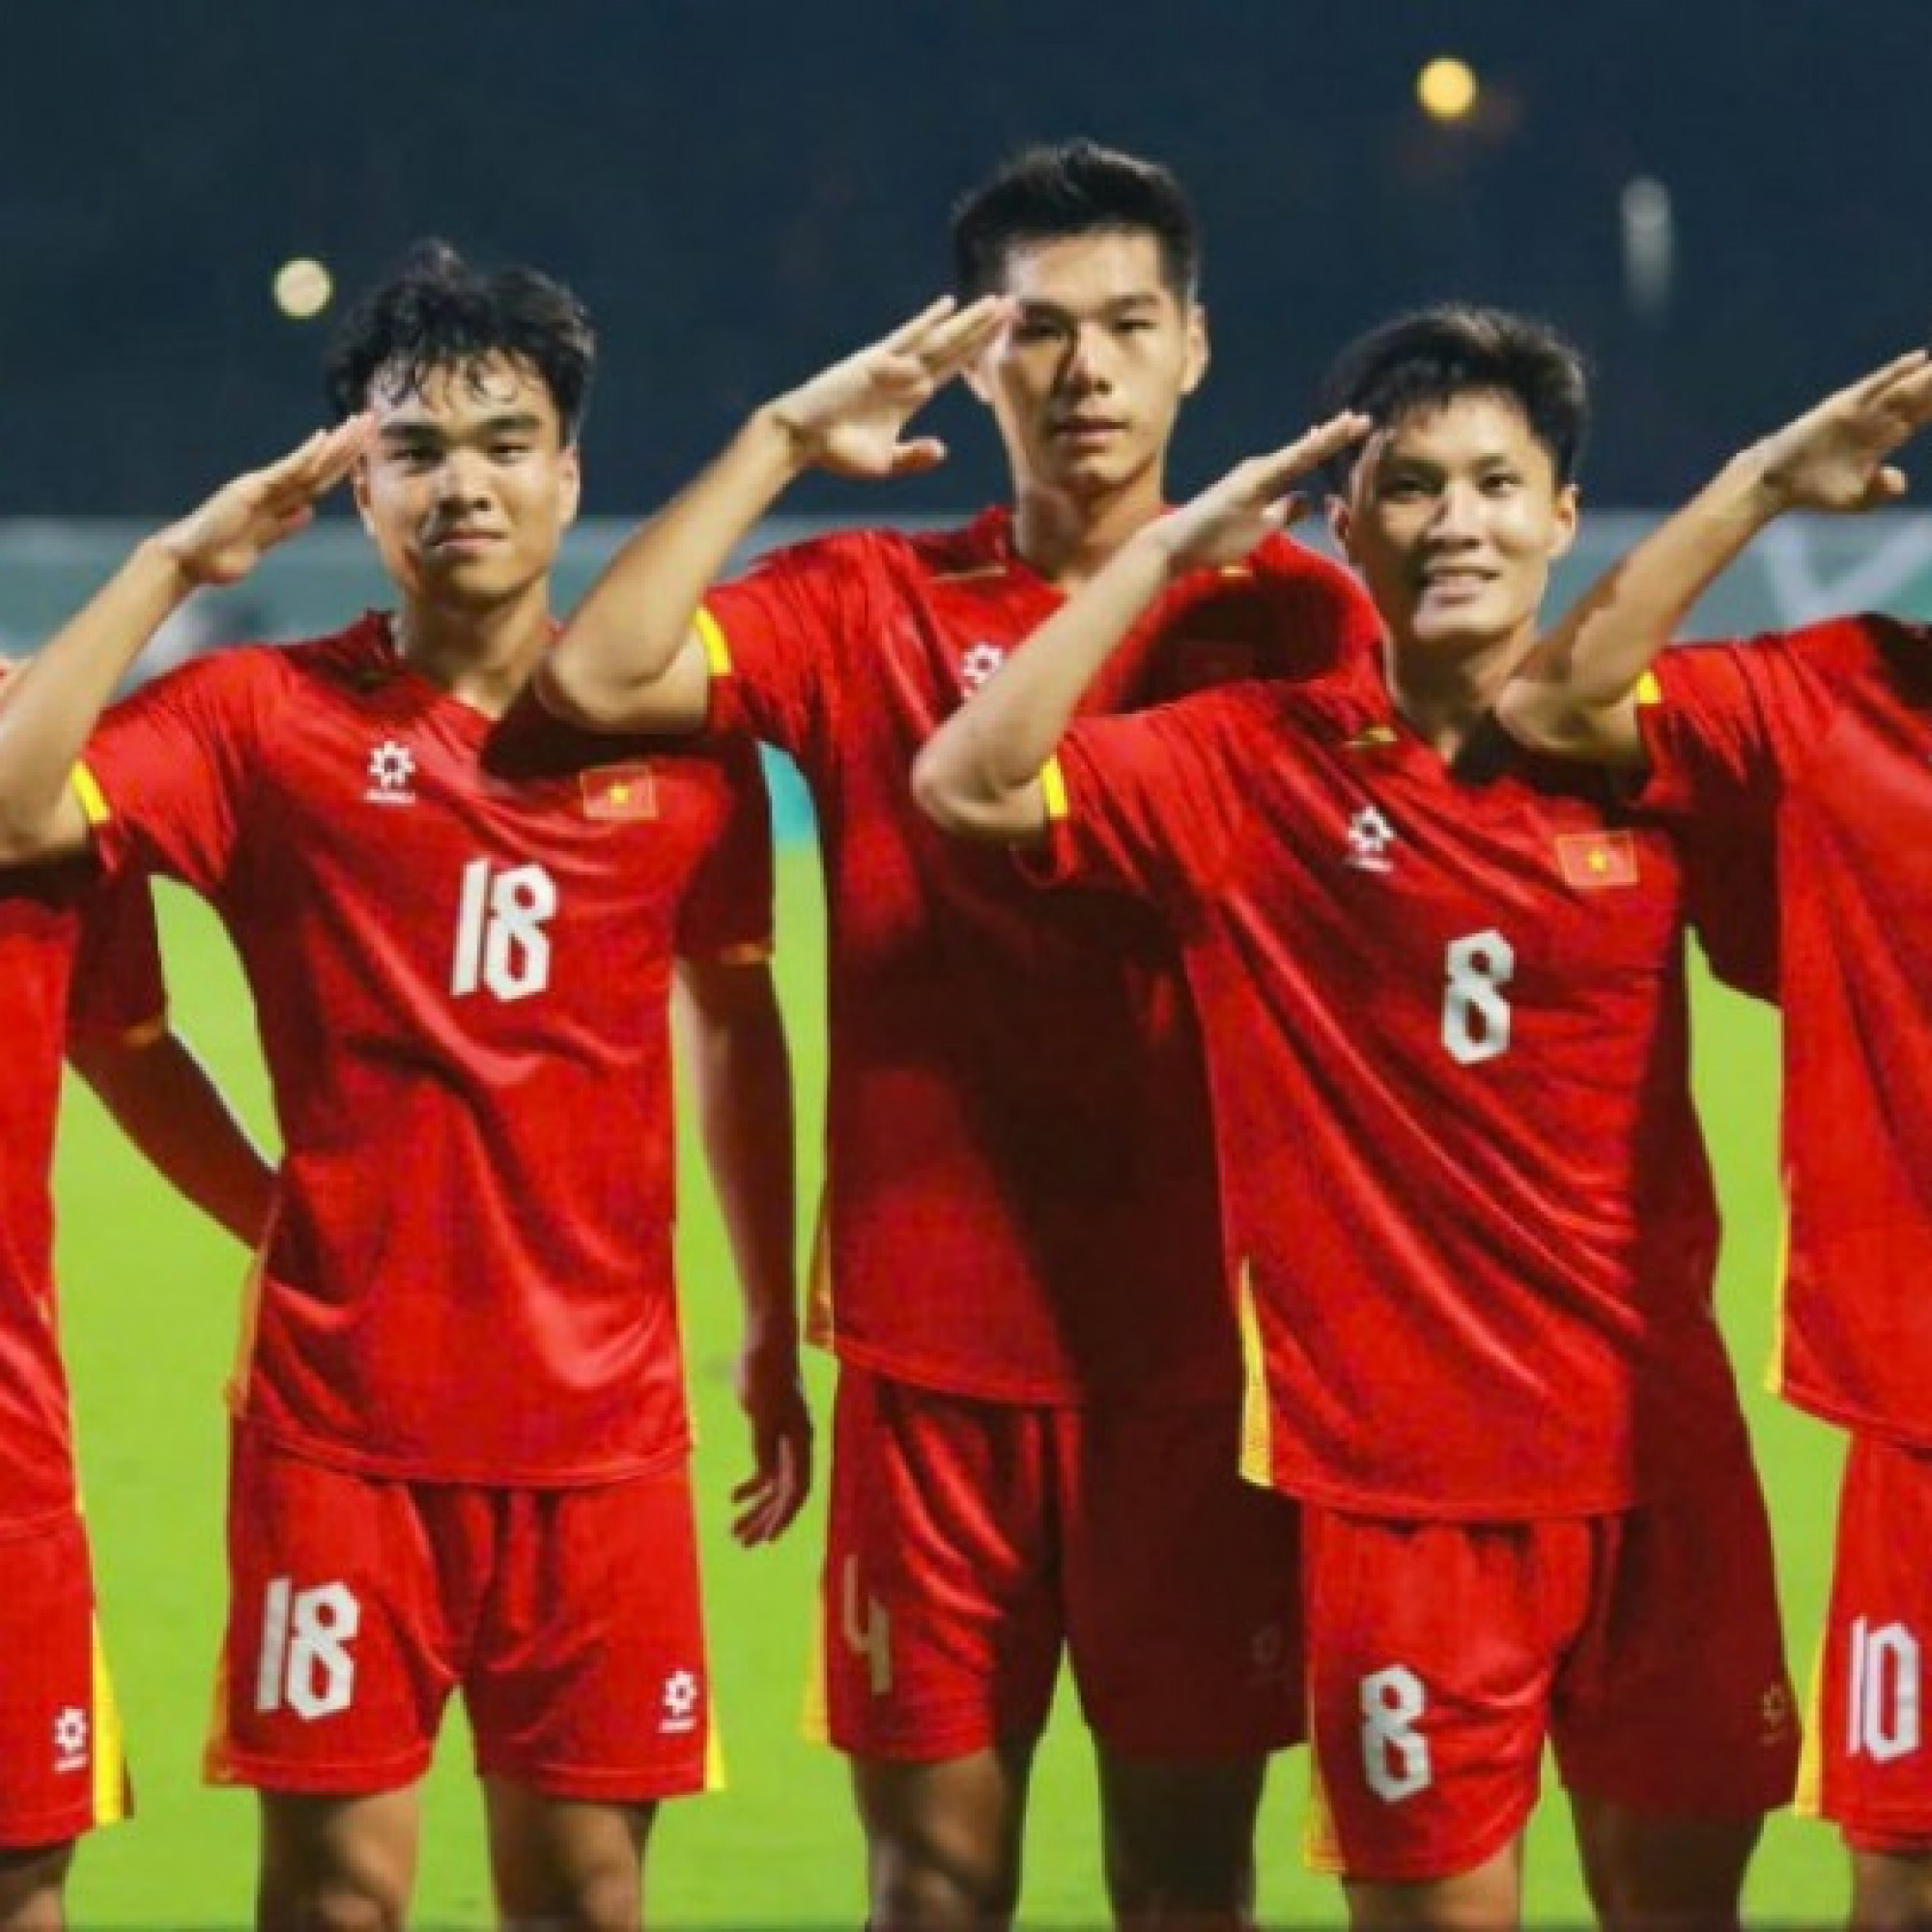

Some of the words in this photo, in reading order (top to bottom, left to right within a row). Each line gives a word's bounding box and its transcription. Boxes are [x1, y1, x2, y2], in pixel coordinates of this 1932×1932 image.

[451, 857, 558, 1001] 18
[1441, 927, 1515, 1065] 8
[255, 1577, 362, 1721] 18
[842, 1554, 894, 1695] 4
[1846, 1614, 1920, 1762] 10
[1358, 1662, 1434, 1804] 8
